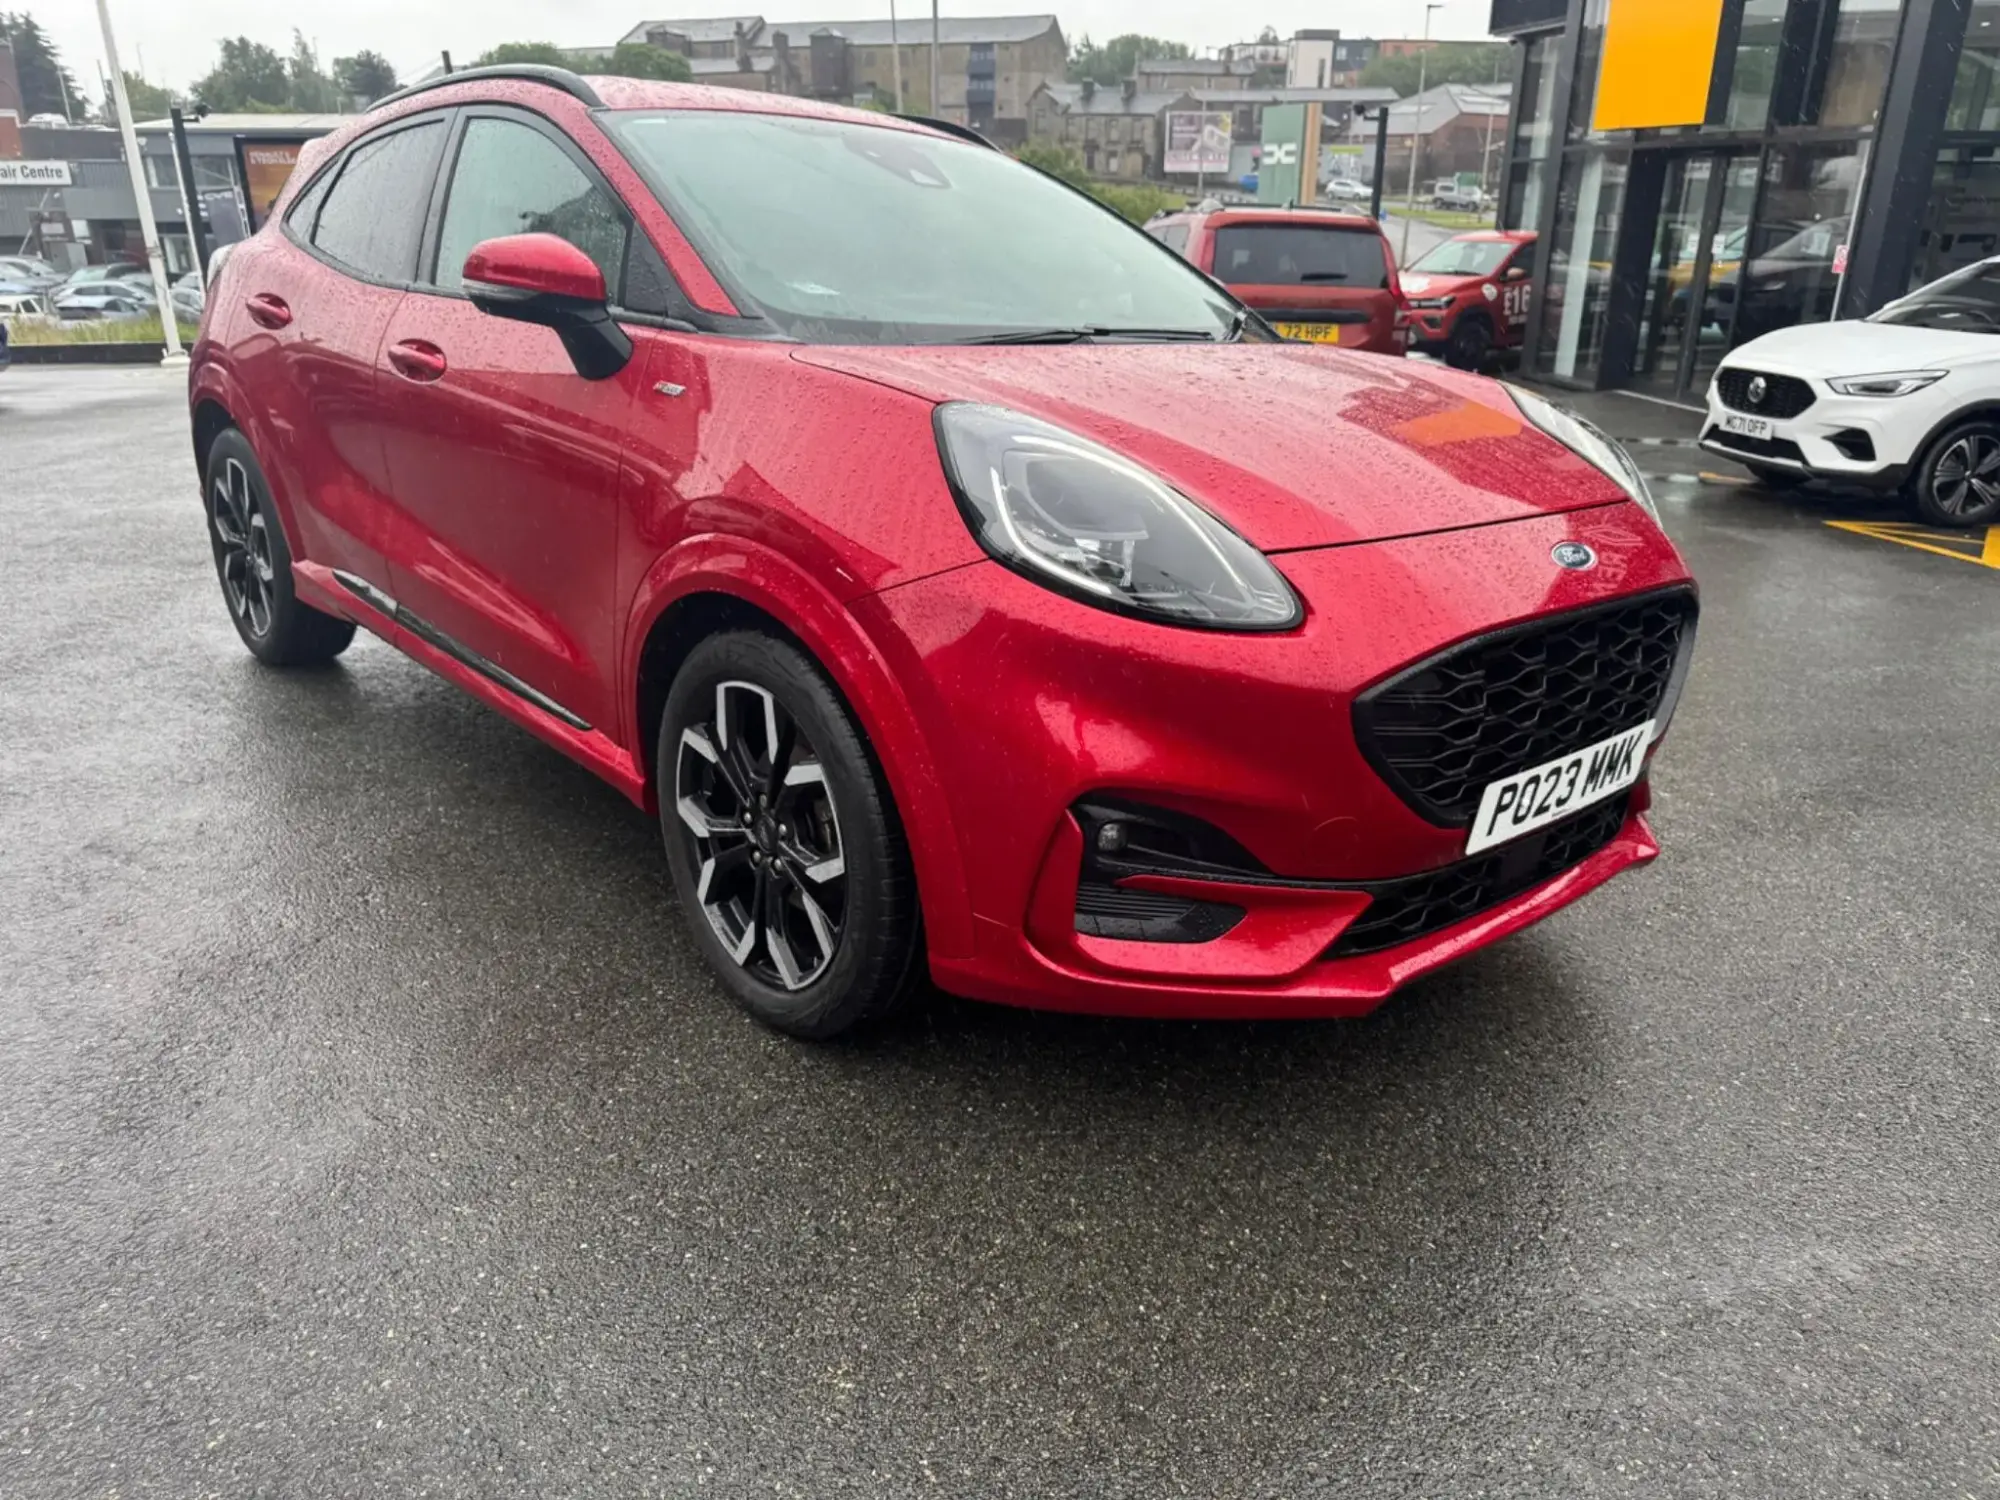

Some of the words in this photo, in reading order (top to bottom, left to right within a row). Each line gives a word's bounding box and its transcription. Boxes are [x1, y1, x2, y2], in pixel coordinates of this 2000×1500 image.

[20, 164, 63, 179] Centre
[1303, 323, 1331, 341] HPF
[1486, 757, 1583, 838] PO23
[1580, 729, 1645, 798] MMK
